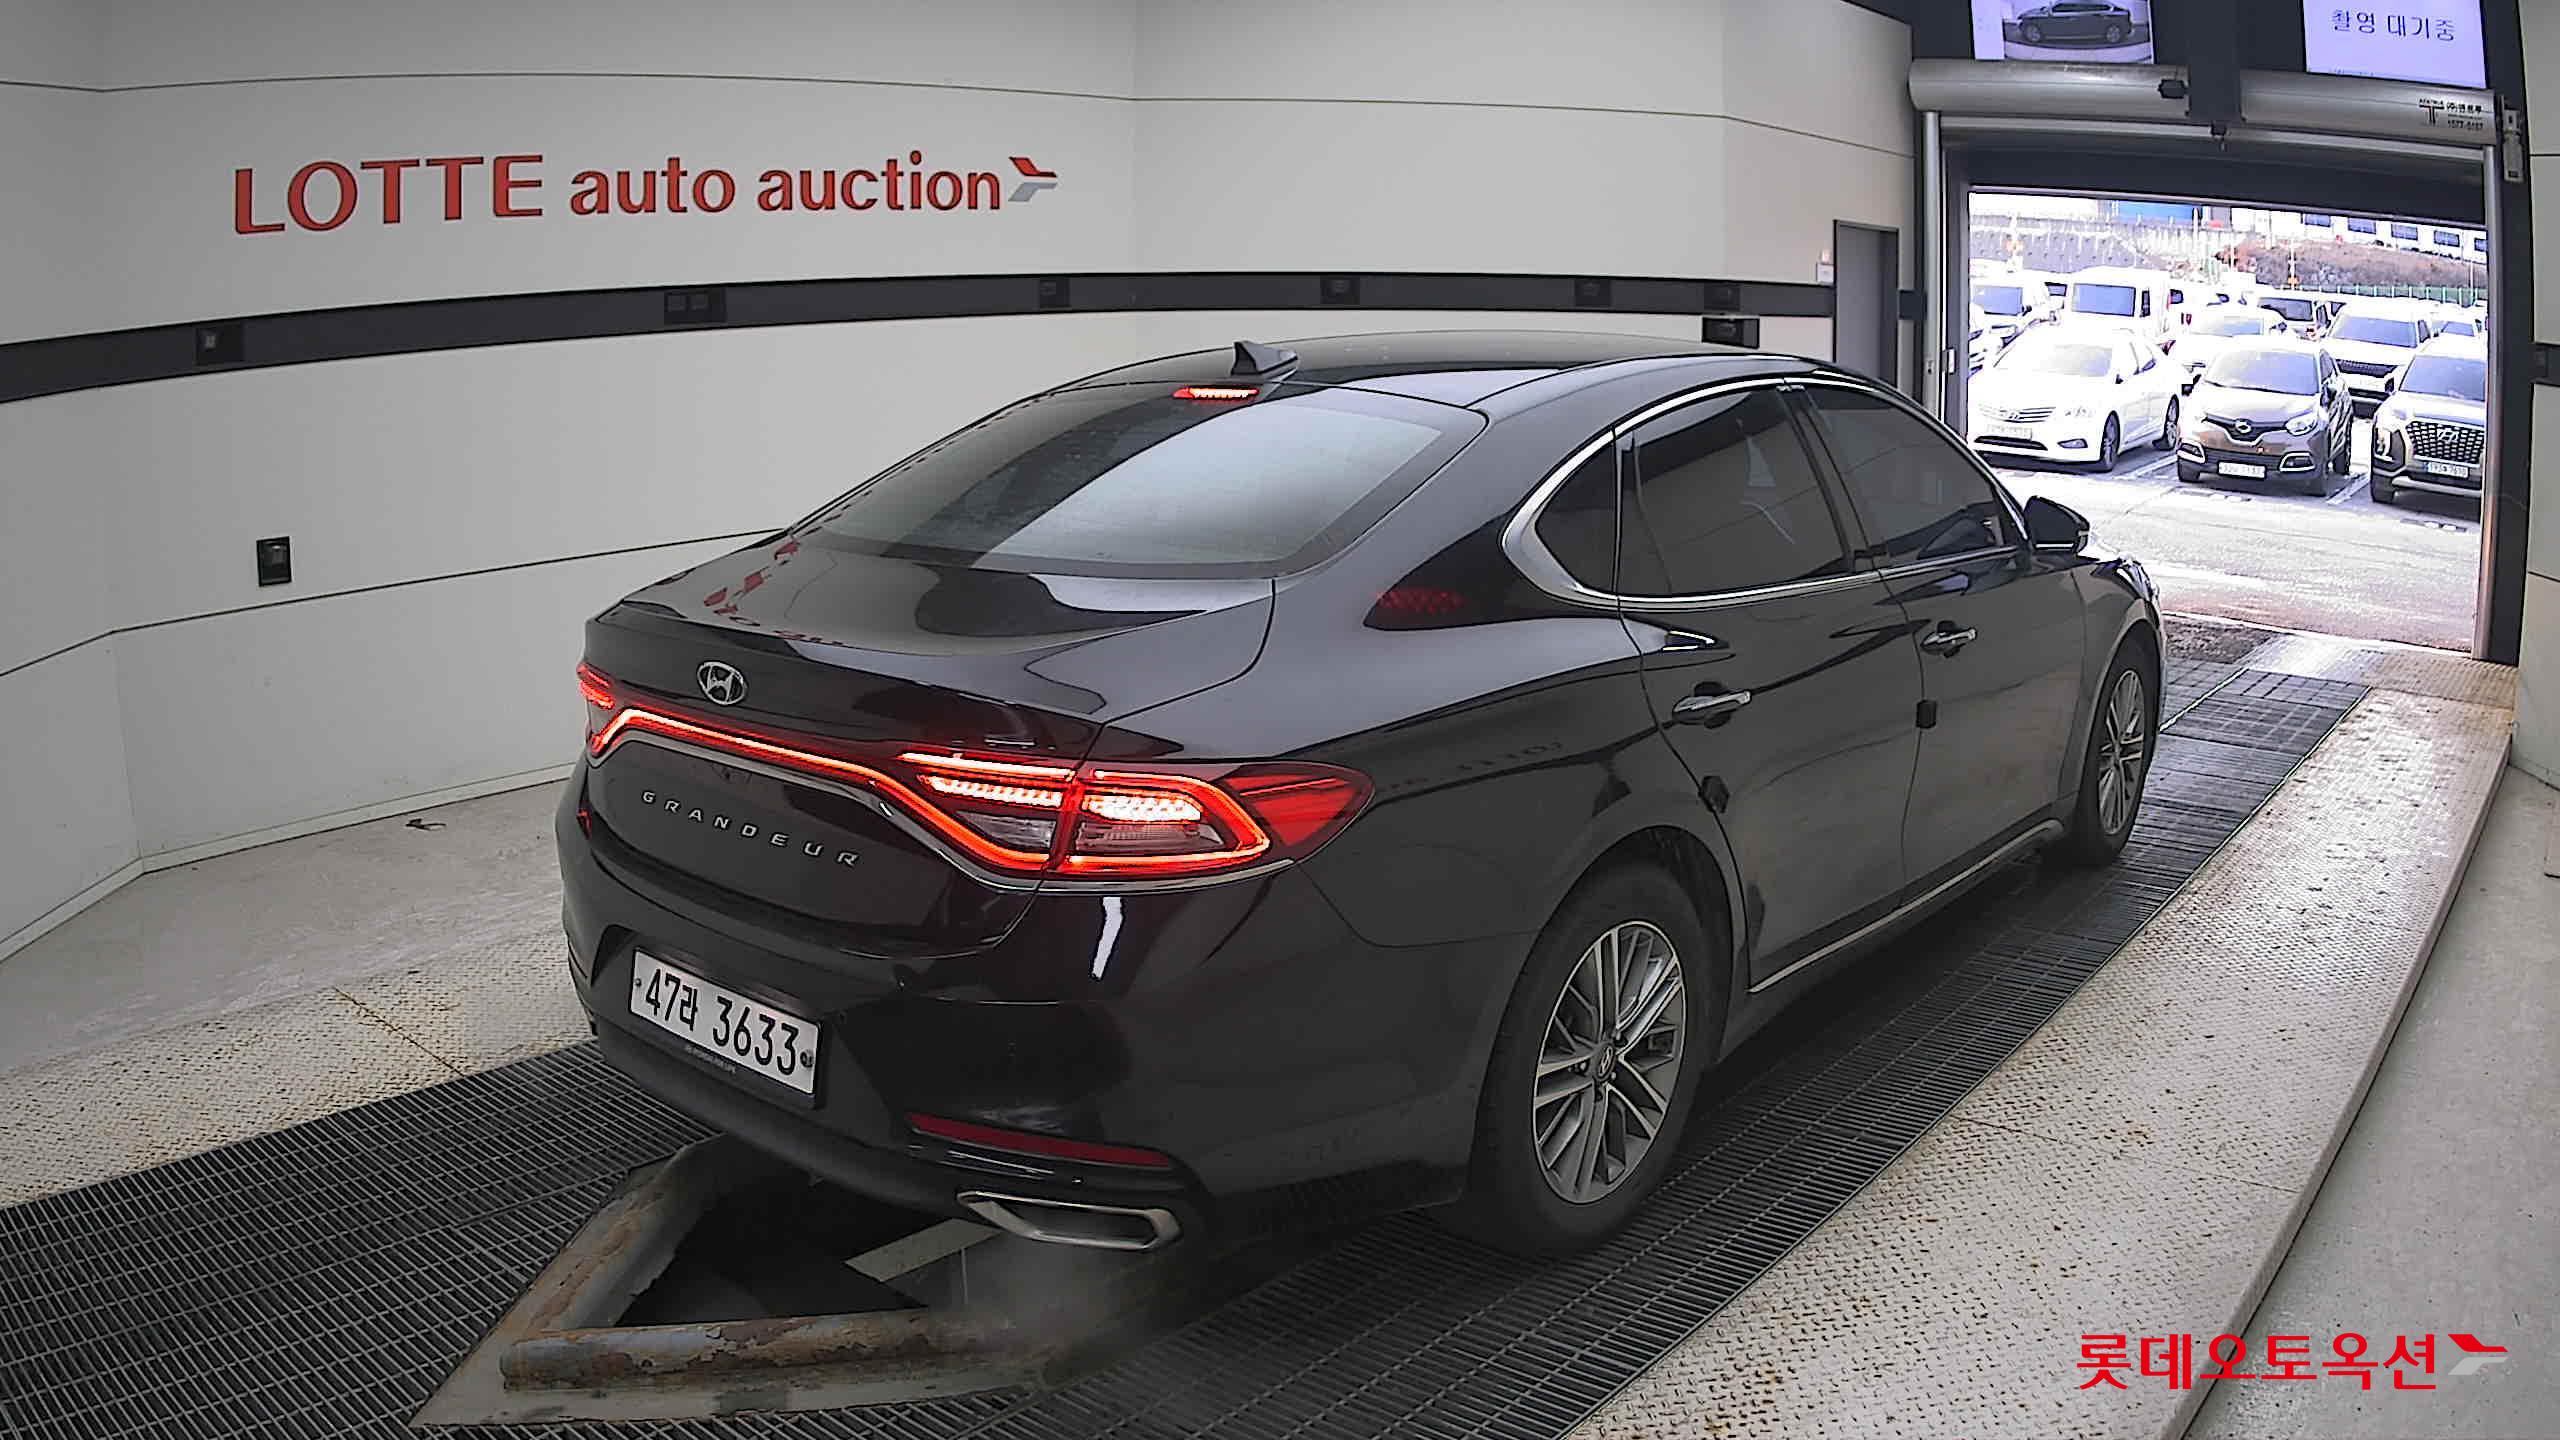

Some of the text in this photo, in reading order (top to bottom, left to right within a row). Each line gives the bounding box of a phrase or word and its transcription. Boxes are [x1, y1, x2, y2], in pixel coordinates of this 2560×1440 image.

[2332, 9, 2454, 41] 촬영 대기중
[234, 150, 1002, 235] LOTTE auto auction
[642, 791, 860, 866] GRANDEUR
[645, 969, 698, 1031] 47라
[713, 996, 799, 1075] 3633
